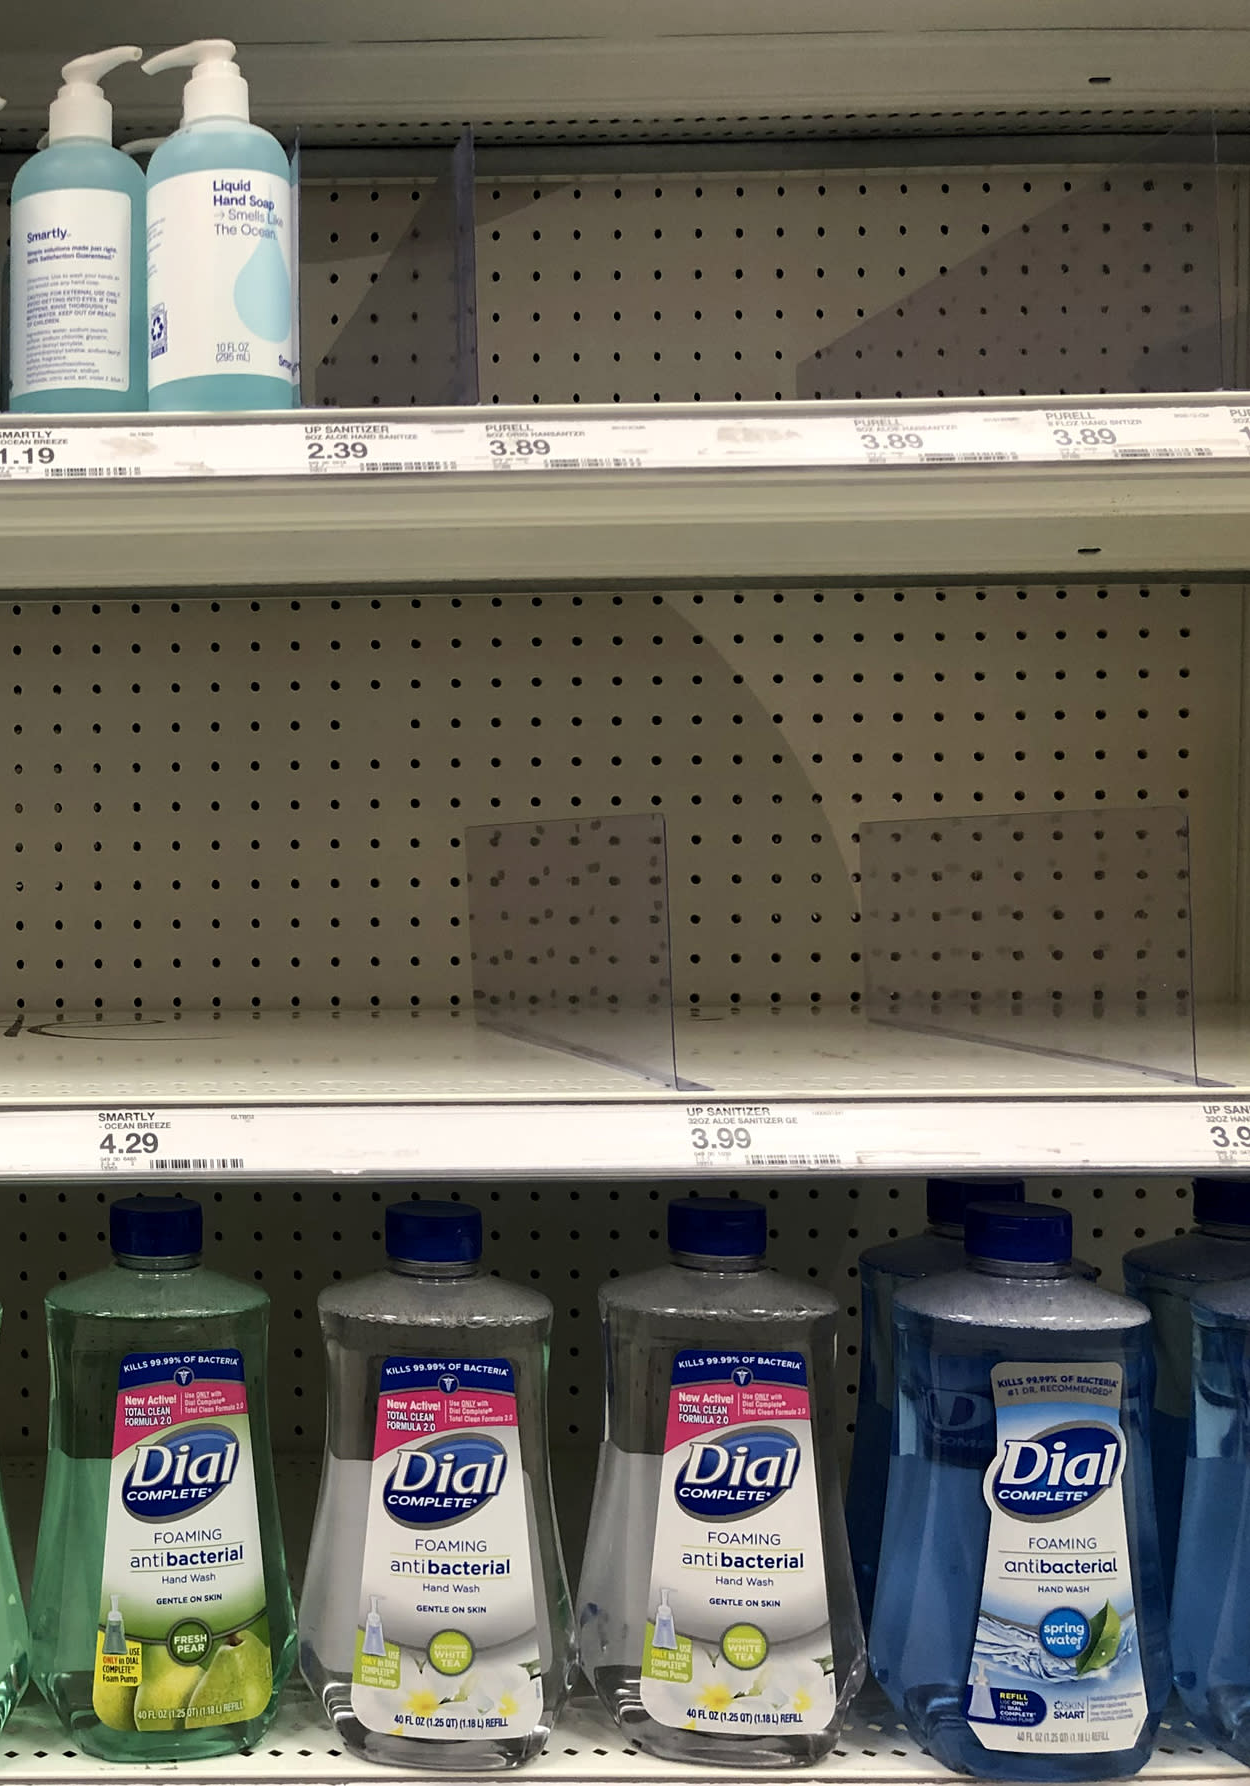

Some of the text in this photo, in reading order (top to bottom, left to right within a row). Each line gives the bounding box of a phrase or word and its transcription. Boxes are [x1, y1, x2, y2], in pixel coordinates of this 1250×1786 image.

[213, 179, 251, 193] Liquid
[213, 195, 274, 211] Hand Soap
[229, 208, 265, 222] Smells
[214, 223, 237, 235] The
[1045, 412, 1095, 420] PURELL
[325, 425, 389, 434] SANITIZER
[861, 433, 923, 449] 3.89
[1053, 428, 1117, 446] 3.89
[307, 442, 368, 459] 2.39
[490, 439, 550, 455] 3.89
[686, 1107, 770, 1116] UP SANITIZER
[1202, 1105, 1220, 1114] UP
[98, 1112, 156, 1122] SMARTLY
[99, 1132, 159, 1154] 4.29
[691, 1127, 751, 1149] 3.99
[386, 1366, 411, 1375] KILLS
[413, 1363, 445, 1371] 99.99%
[130, 1442, 237, 1487] Dial
[683, 1442, 798, 1487] Dial
[1000, 1440, 1117, 1486] Dial
[391, 1450, 505, 1494] Dial
[154, 1528, 222, 1544] FOAMING
[708, 1532, 781, 1545] FOAMING
[415, 1539, 487, 1552] FOAMING
[1029, 1538, 1097, 1549] FOAMING
[131, 1545, 243, 1567] antibacterial
[682, 1552, 804, 1569] antibacterial
[391, 1559, 510, 1575] antibacterial
[1004, 1558, 1117, 1574] antibacterial
[423, 1584, 480, 1593] Hand Wash
[1044, 1624, 1084, 1636] spring
[174, 1635, 207, 1644] FRESH
[1046, 1636, 1082, 1646] water
[177, 1644, 205, 1653] PEAR
[728, 1645, 761, 1653] WHITE
[735, 1653, 754, 1661] TEA
[1000, 1692, 1028, 1700] REFILL
[394, 1714, 404, 1723] 40
[405, 1716, 414, 1725] FL
[415, 1717, 425, 1726] OZ
[485, 1718, 508, 1727] REFILL
[1053, 1711, 1085, 1719] SMART
